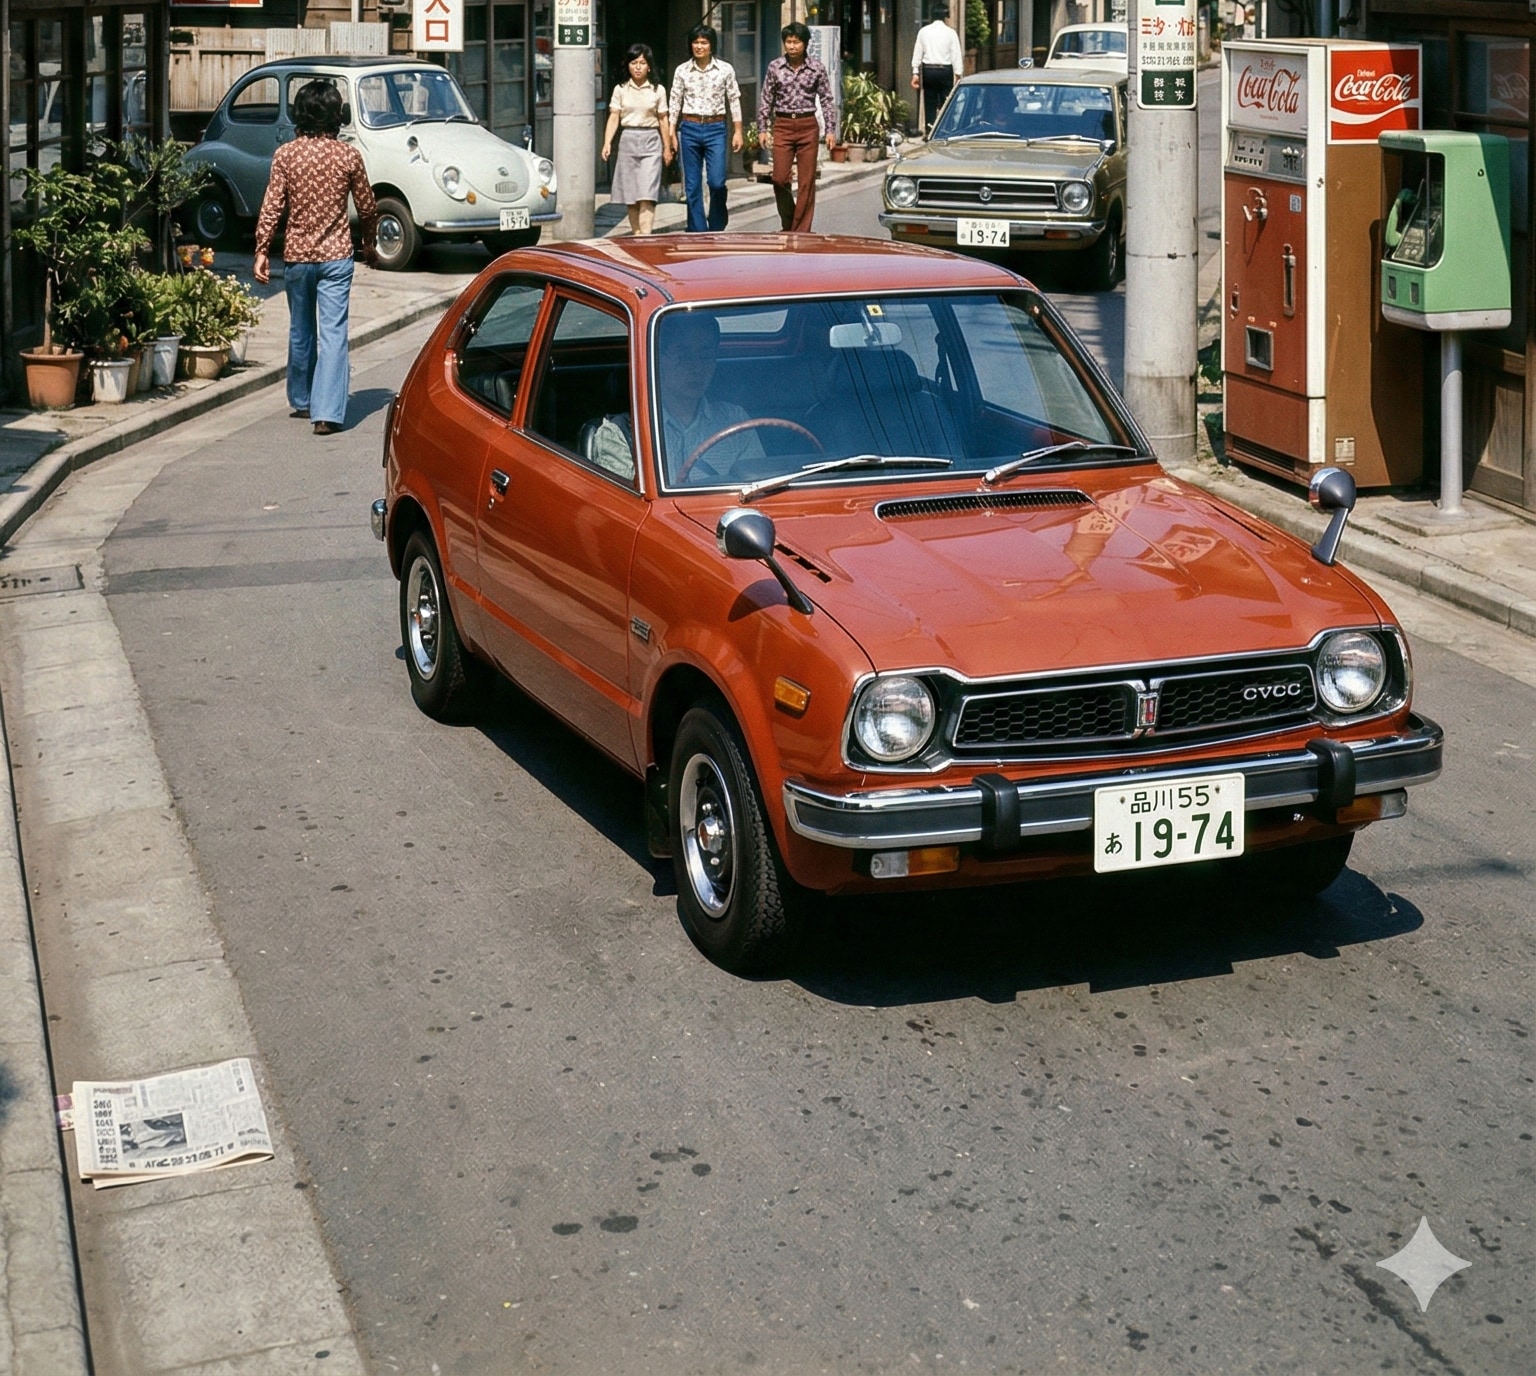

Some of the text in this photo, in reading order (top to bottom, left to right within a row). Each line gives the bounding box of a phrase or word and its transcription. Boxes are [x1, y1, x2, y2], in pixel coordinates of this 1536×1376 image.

[1243, 683, 1301, 701] CVCC
[1130, 784, 1210, 814] 品川55
[1104, 810, 1235, 862] あ 19-74
